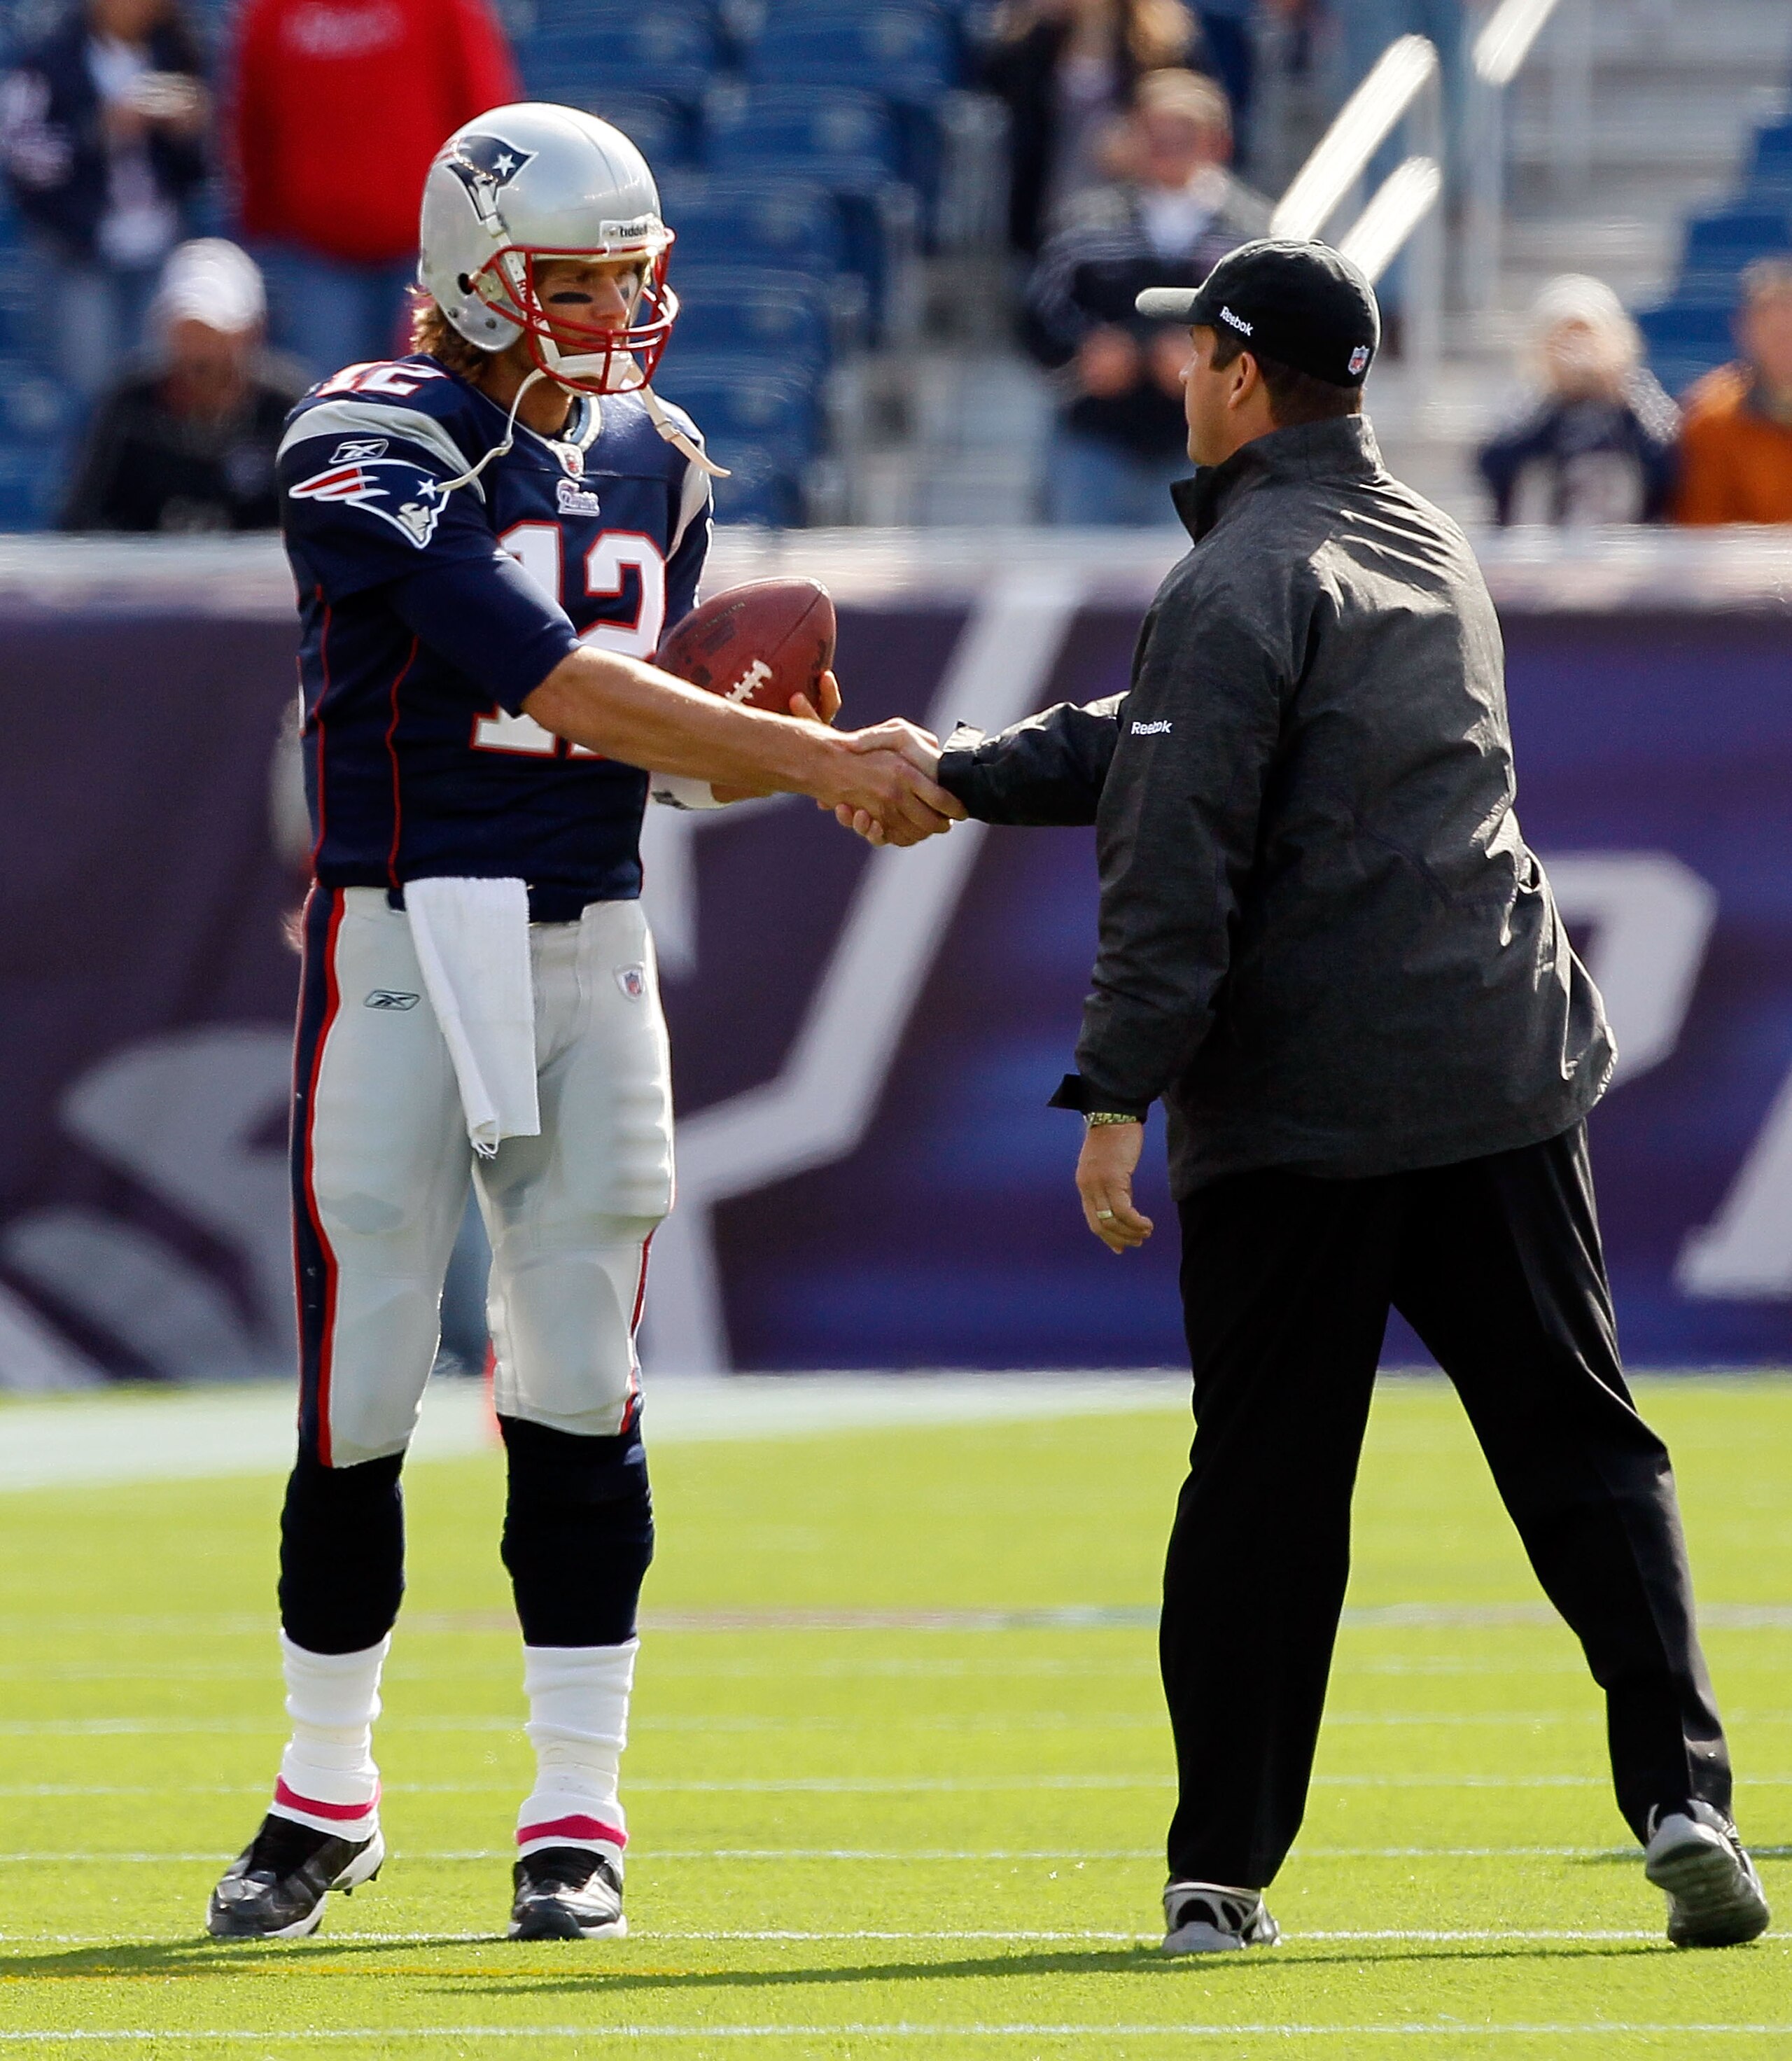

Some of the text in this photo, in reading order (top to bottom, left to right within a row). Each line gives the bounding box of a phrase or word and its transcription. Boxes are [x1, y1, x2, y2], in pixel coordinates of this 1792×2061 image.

[1220, 306, 1253, 336] Reebok
[316, 360, 451, 398] 12
[470, 520, 667, 760] 12
[1130, 720, 1172, 734] Reebok
